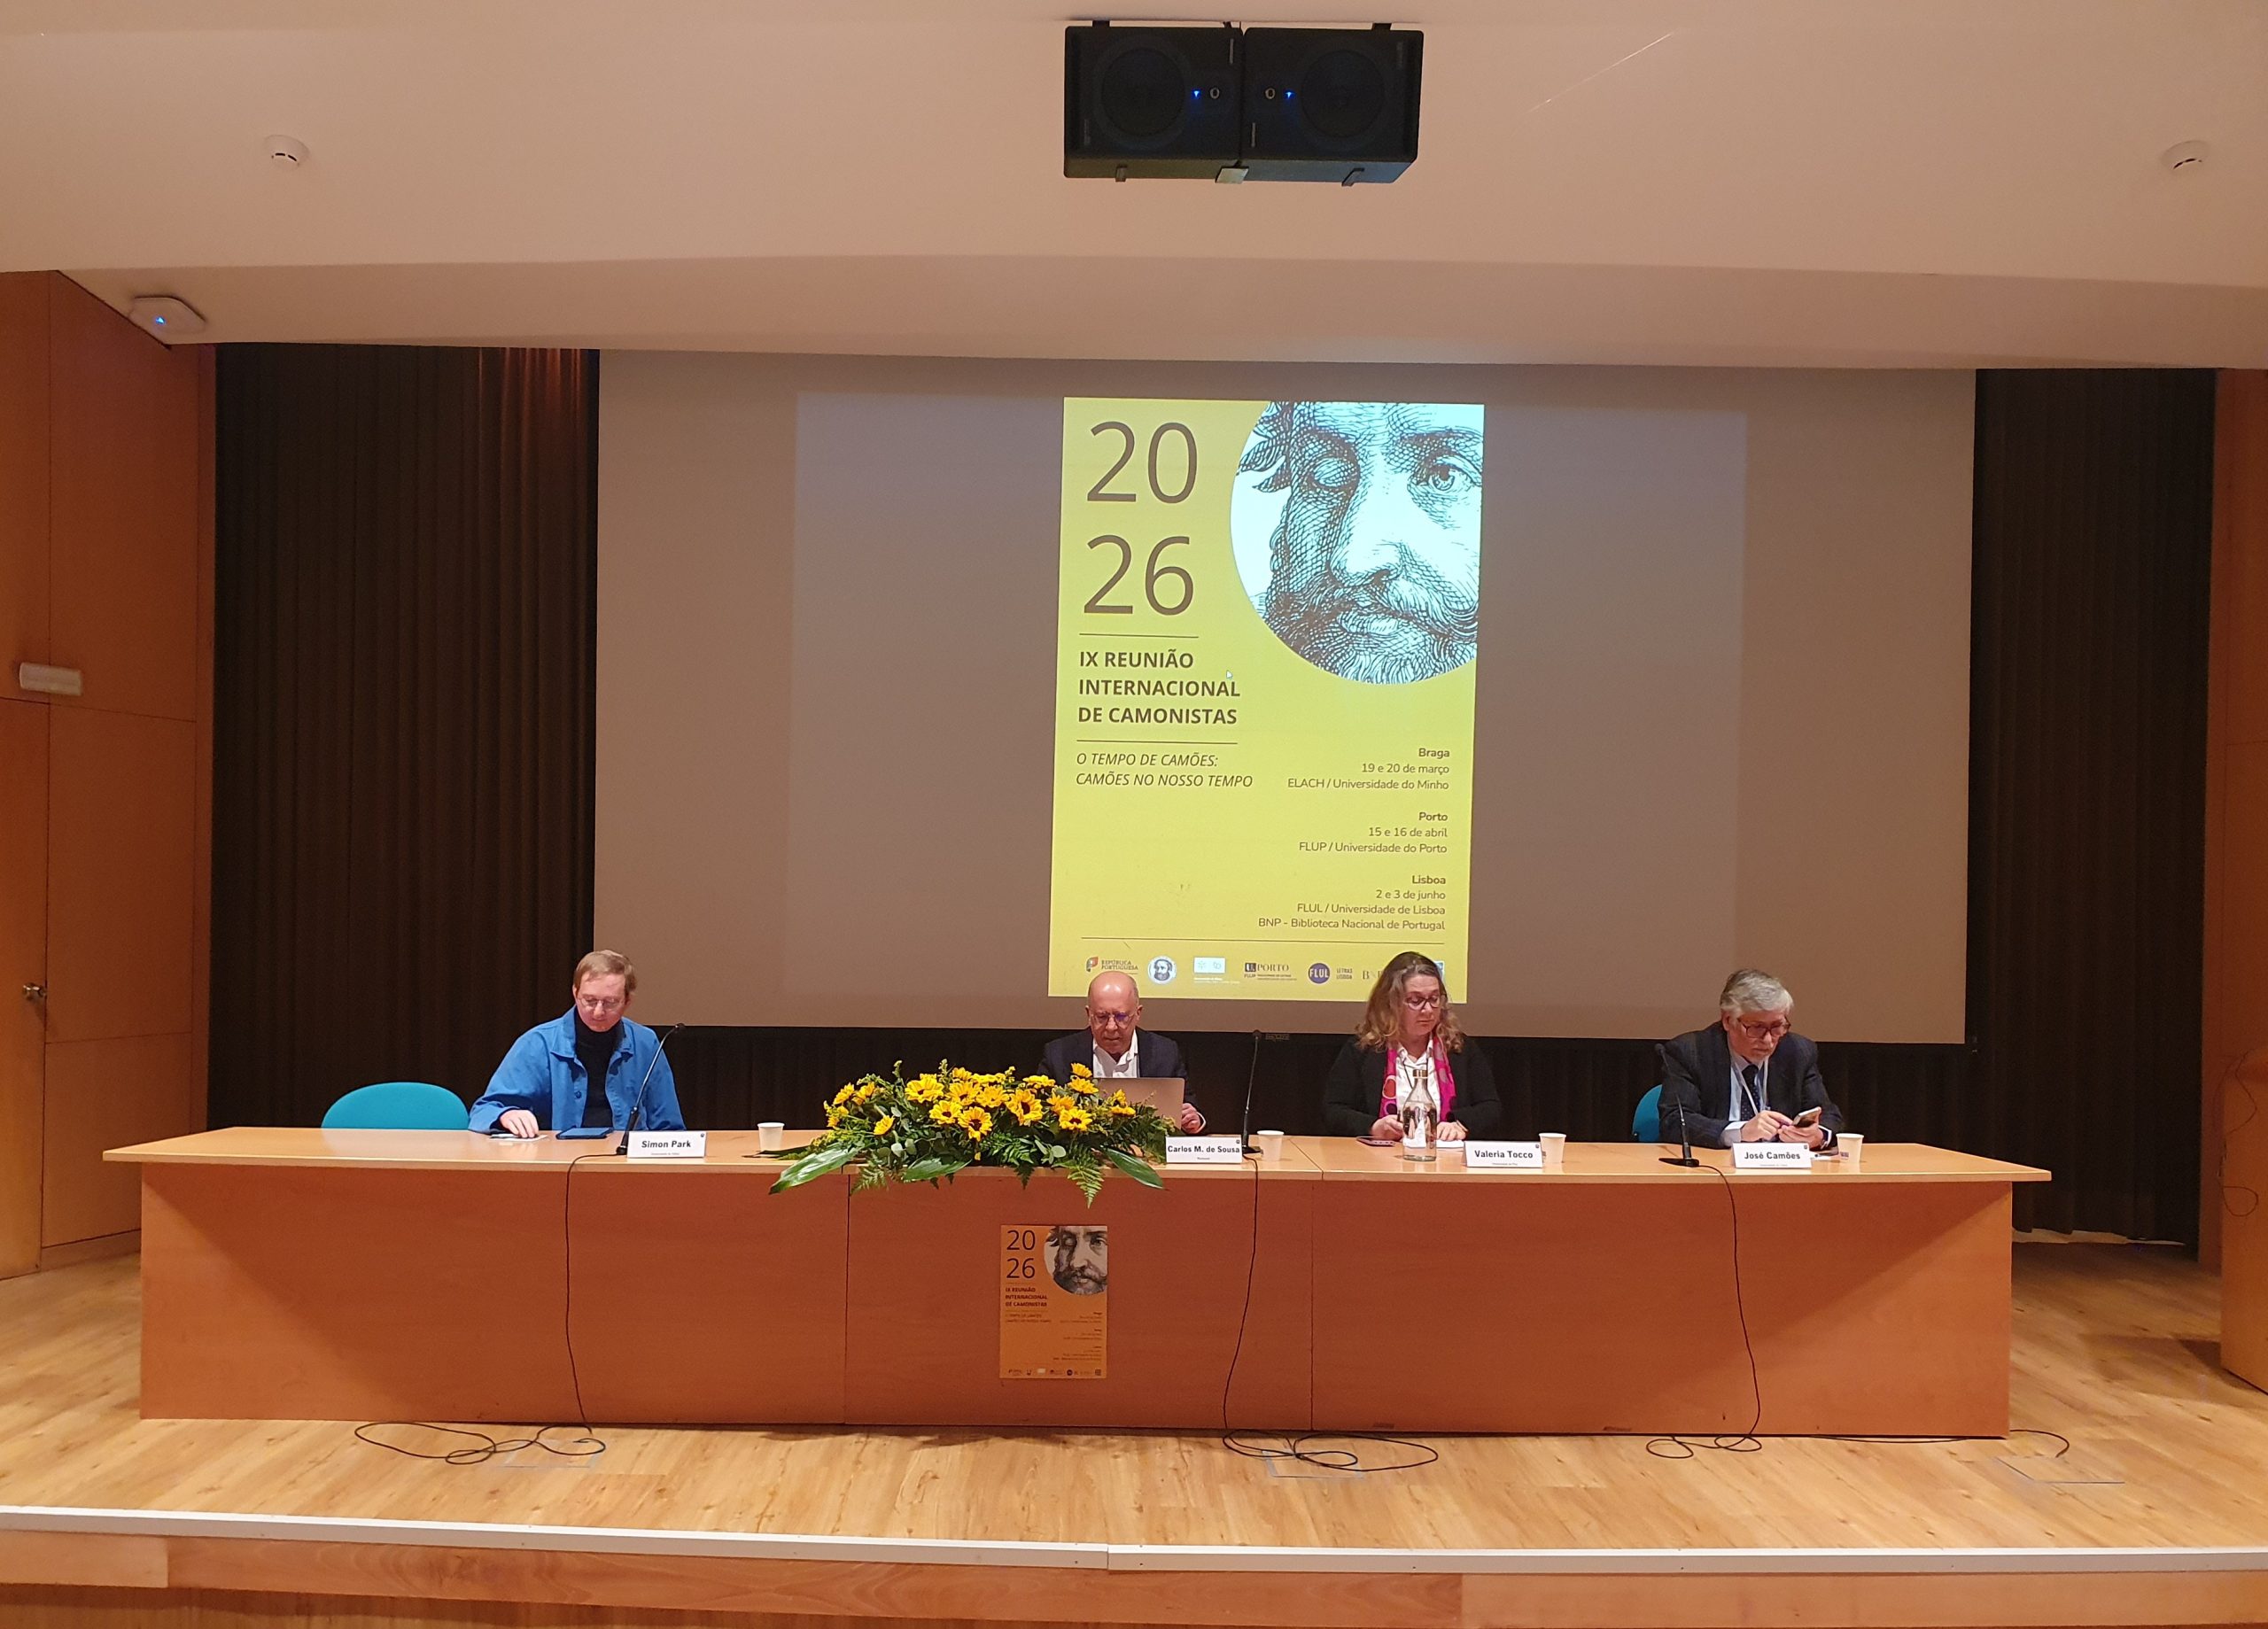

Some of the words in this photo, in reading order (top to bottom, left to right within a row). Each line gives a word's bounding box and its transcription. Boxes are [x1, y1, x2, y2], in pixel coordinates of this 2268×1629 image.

[1086, 421, 1199, 504] 20
[1084, 534, 1194, 616] 26
[1080, 651, 1099, 667] IX
[1105, 648, 1193, 669] REUNIÃO
[1079, 679, 1240, 697] INTERNACIONAL
[1078, 707, 1103, 723] DE
[1108, 708, 1237, 725] CAMONISTAS
[1076, 752, 1087, 764] O
[1091, 753, 1136, 766] TEMPO
[1139, 754, 1158, 766] DE
[1161, 752, 1219, 767] CAMÕES:
[1418, 748, 1450, 759] Braga
[1362, 763, 1375, 773] 19
[1386, 764, 1400, 773] 20
[1402, 764, 1416, 773] de
[1418, 766, 1450, 775] março
[1076, 771, 1130, 786] CAMÕES
[1133, 773, 1154, 786] NO
[1158, 774, 1204, 787] NOSSO
[1208, 775, 1254, 787] TEMPO
[1287, 778, 1324, 788] ELACH
[1326, 778, 1332, 789] /
[1332, 779, 1400, 789] Universidade
[1402, 779, 1415, 789] do
[1417, 780, 1449, 790] Minho
[1418, 812, 1449, 821] Porto
[1369, 827, 1382, 836] 15
[1394, 827, 1407, 837] 16
[1410, 827, 1423, 837] de
[1425, 827, 1449, 837] abril
[1299, 842, 1327, 852] FLUP
[1328, 842, 1334, 852] /
[1335, 842, 1402, 852] Universidade
[1403, 842, 1417, 853] do
[1419, 843, 1448, 853] Porto
[1411, 875, 1447, 885] Lisboa
[1376, 889, 1382, 899] 2
[1394, 890, 1401, 899] 3
[1402, 890, 1416, 899] de
[1417, 890, 1446, 901] junho
[1297, 904, 1323, 913] FLUL
[1331, 904, 1395, 914] Universidade
[1397, 904, 1410, 914] de
[1413, 905, 1446, 915] Lisboa
[1258, 918, 1282, 927] BNP
[1291, 918, 1340, 928] Biblioteca
[1341, 919, 1385, 929] Nacional
[1386, 919, 1400, 929] de
[1402, 920, 1446, 932] Portugal
[1309, 968, 1329, 978] FLUL
[1006, 1230, 1036, 1251] 20
[1006, 1258, 1036, 1279] 26
